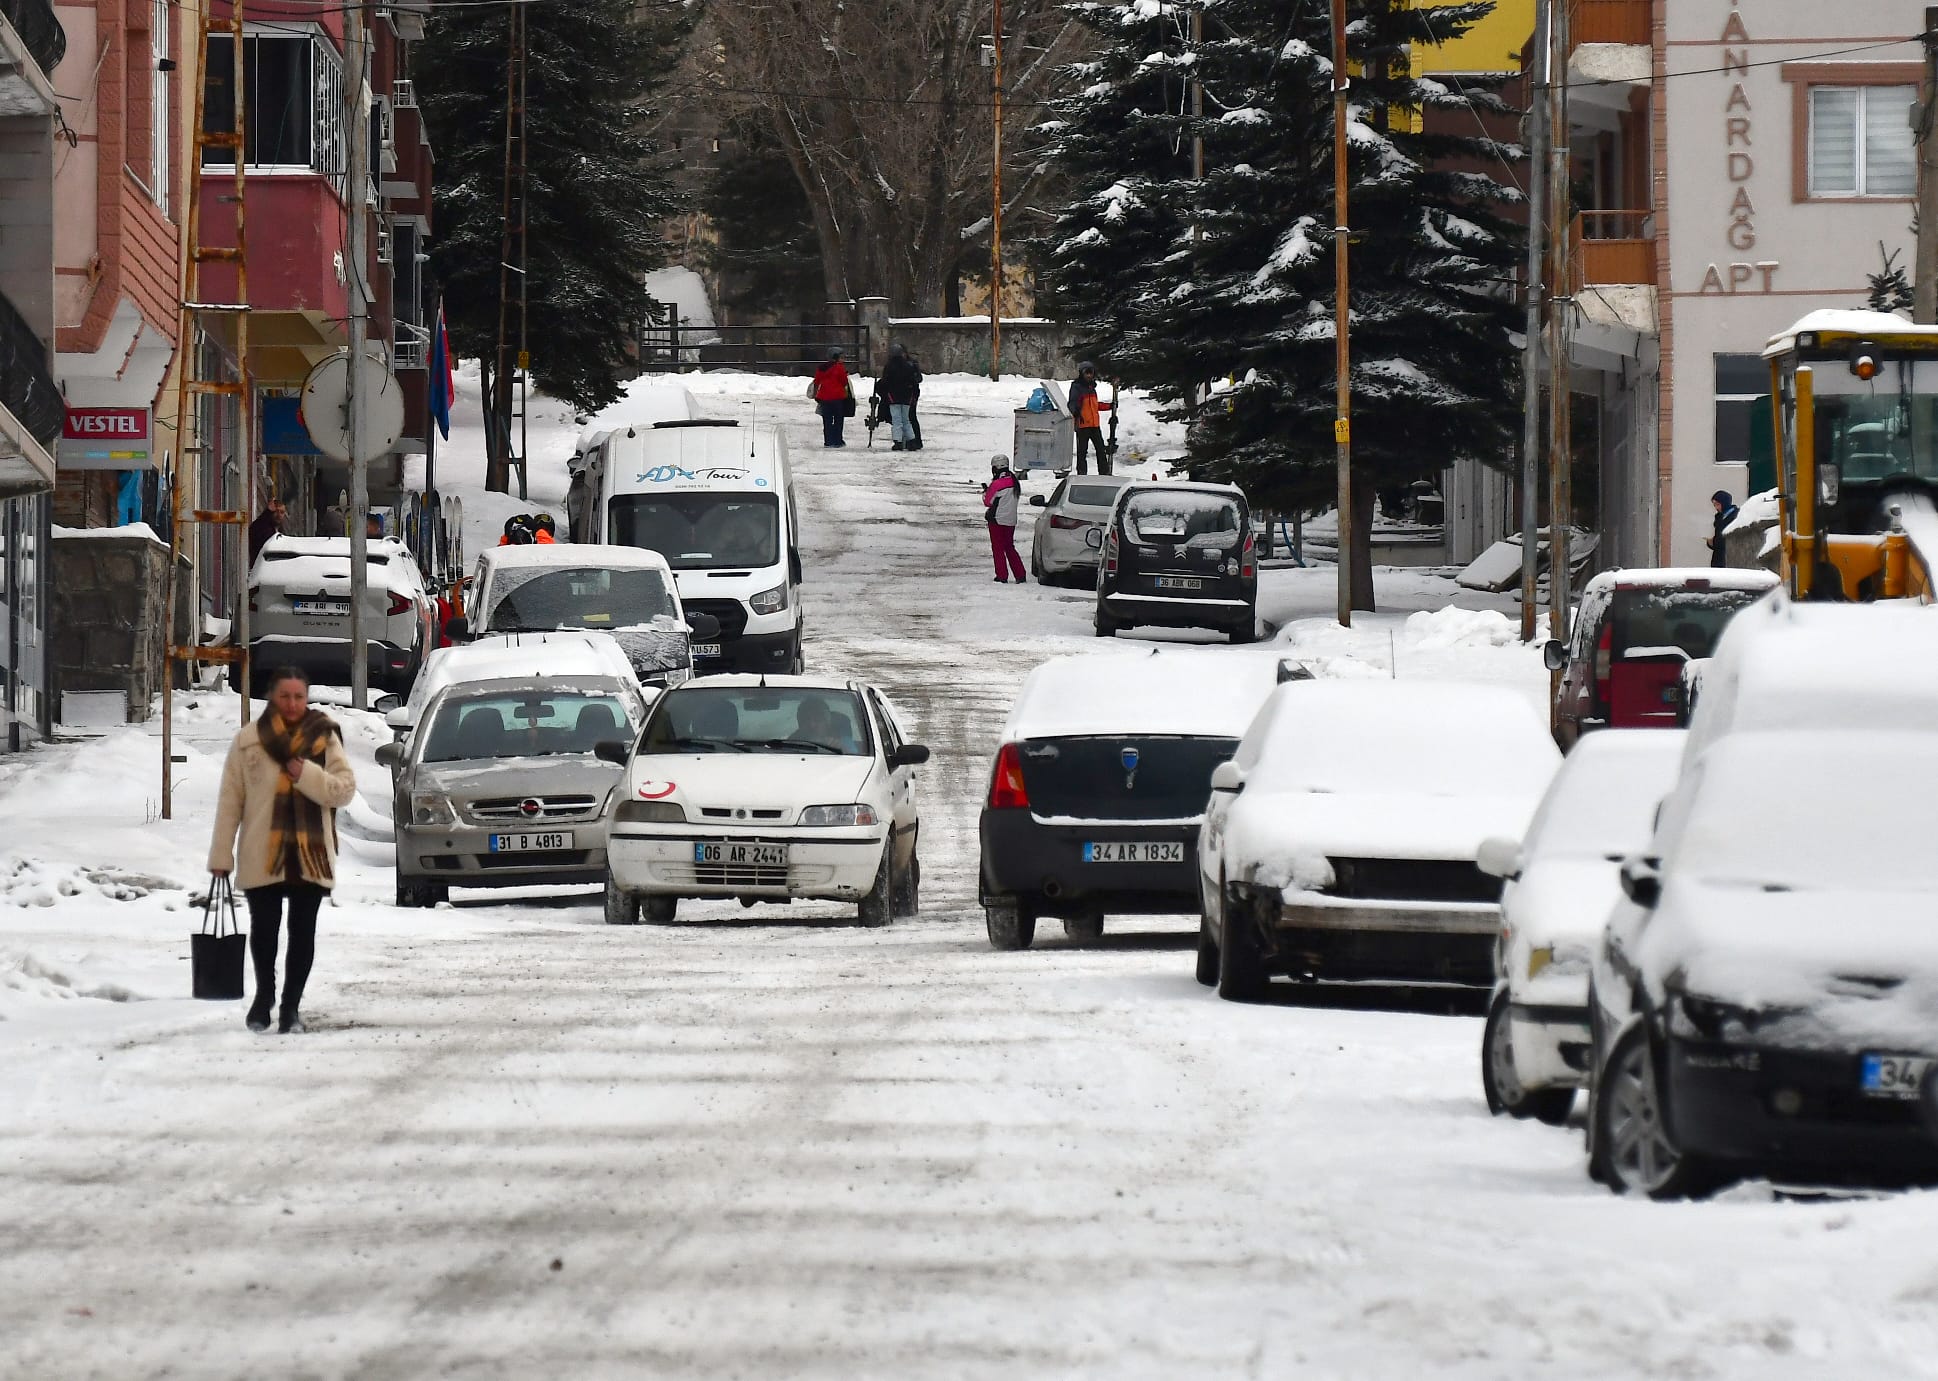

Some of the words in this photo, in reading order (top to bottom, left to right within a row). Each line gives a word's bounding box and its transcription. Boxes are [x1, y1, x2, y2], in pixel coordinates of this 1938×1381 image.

[1700, 260, 1779, 294] APT
[69, 415, 140, 433] VESTEL
[695, 467, 751, 480] Tour
[703, 645, 720, 654] 573
[499, 835, 511, 850] 31
[520, 835, 528, 849] B
[535, 834, 563, 848] 4813
[704, 845, 721, 860] 06
[730, 846, 746, 862] AR
[753, 847, 783, 863] 2441
[1092, 844, 1111, 861] 34
[1118, 844, 1137, 860] AR
[1144, 844, 1180, 860] 1834
[1882, 1060, 1918, 1088] 34
